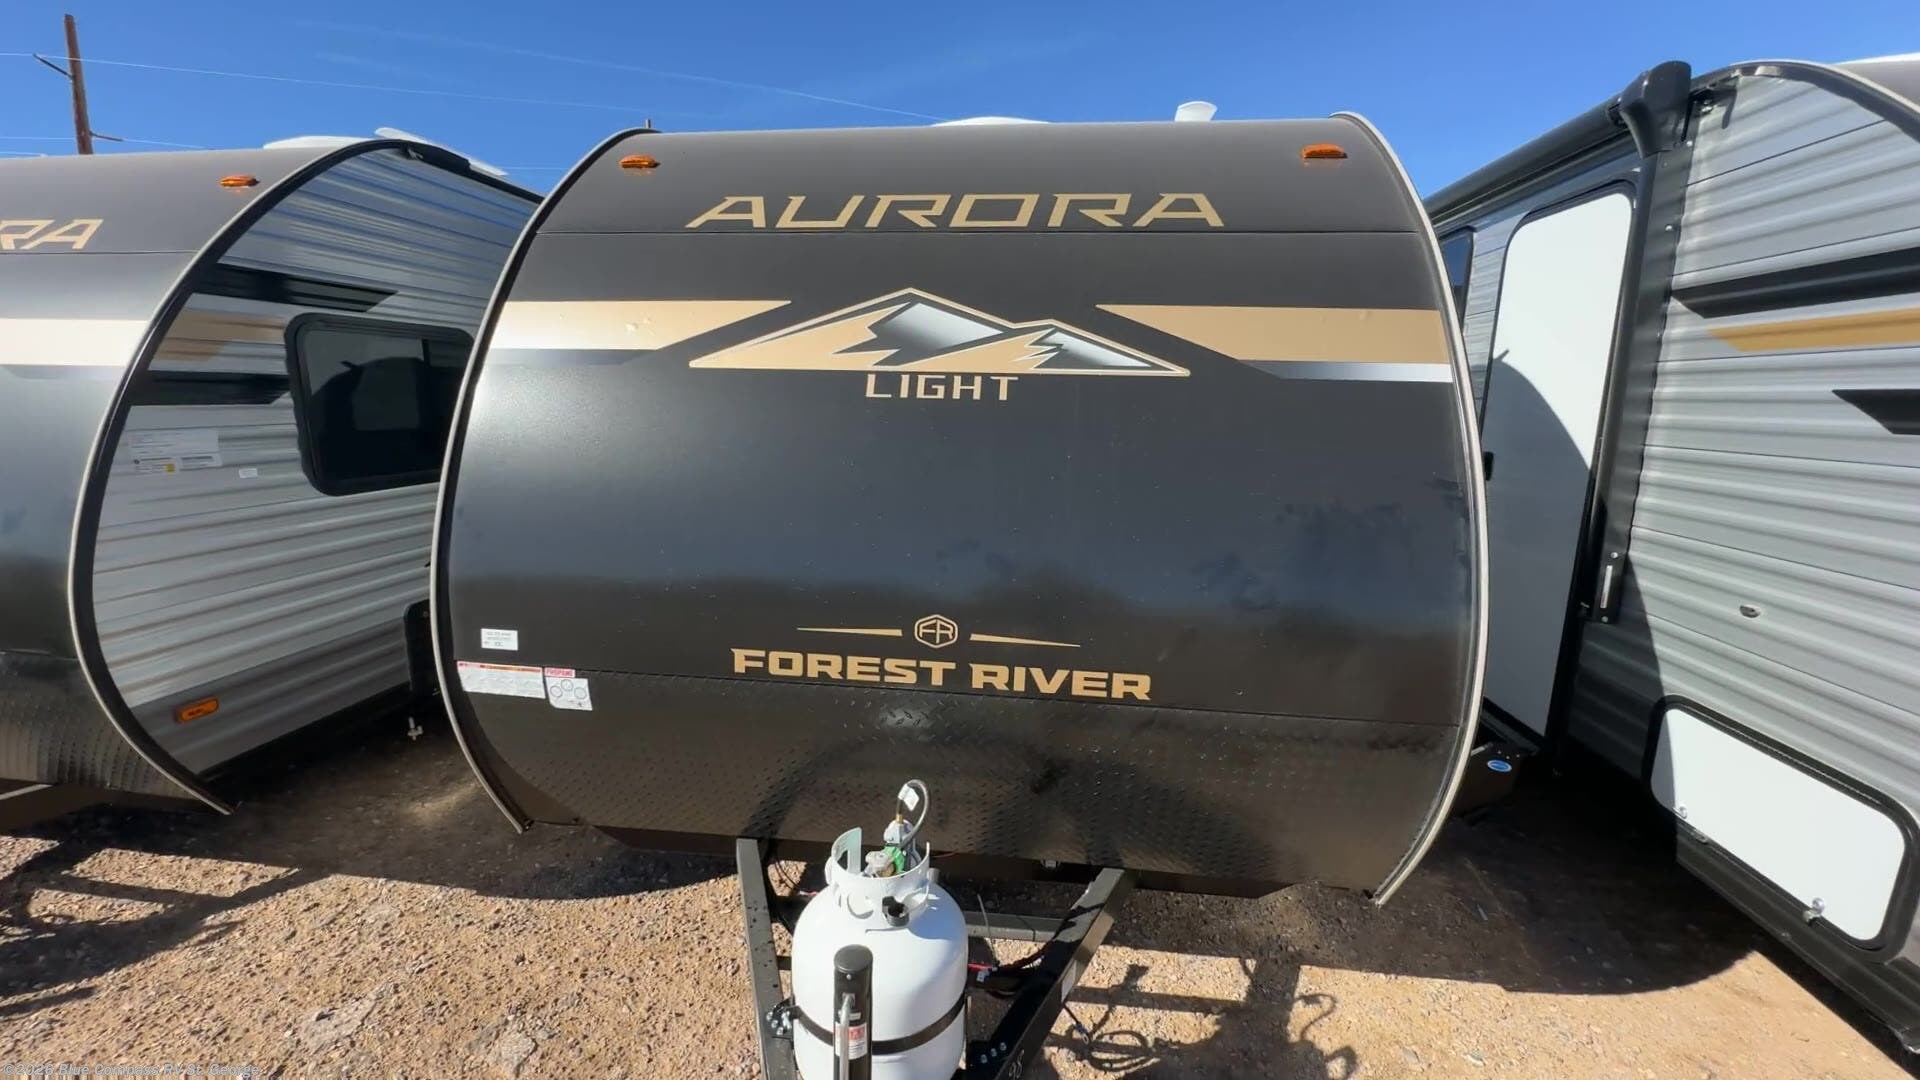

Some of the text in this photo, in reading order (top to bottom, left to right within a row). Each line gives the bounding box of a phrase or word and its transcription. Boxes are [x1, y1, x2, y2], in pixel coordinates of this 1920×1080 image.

[685, 193, 1225, 229] AURORA
[865, 373, 1019, 401] LIGHT
[730, 648, 1152, 700] FOREST RIVER
